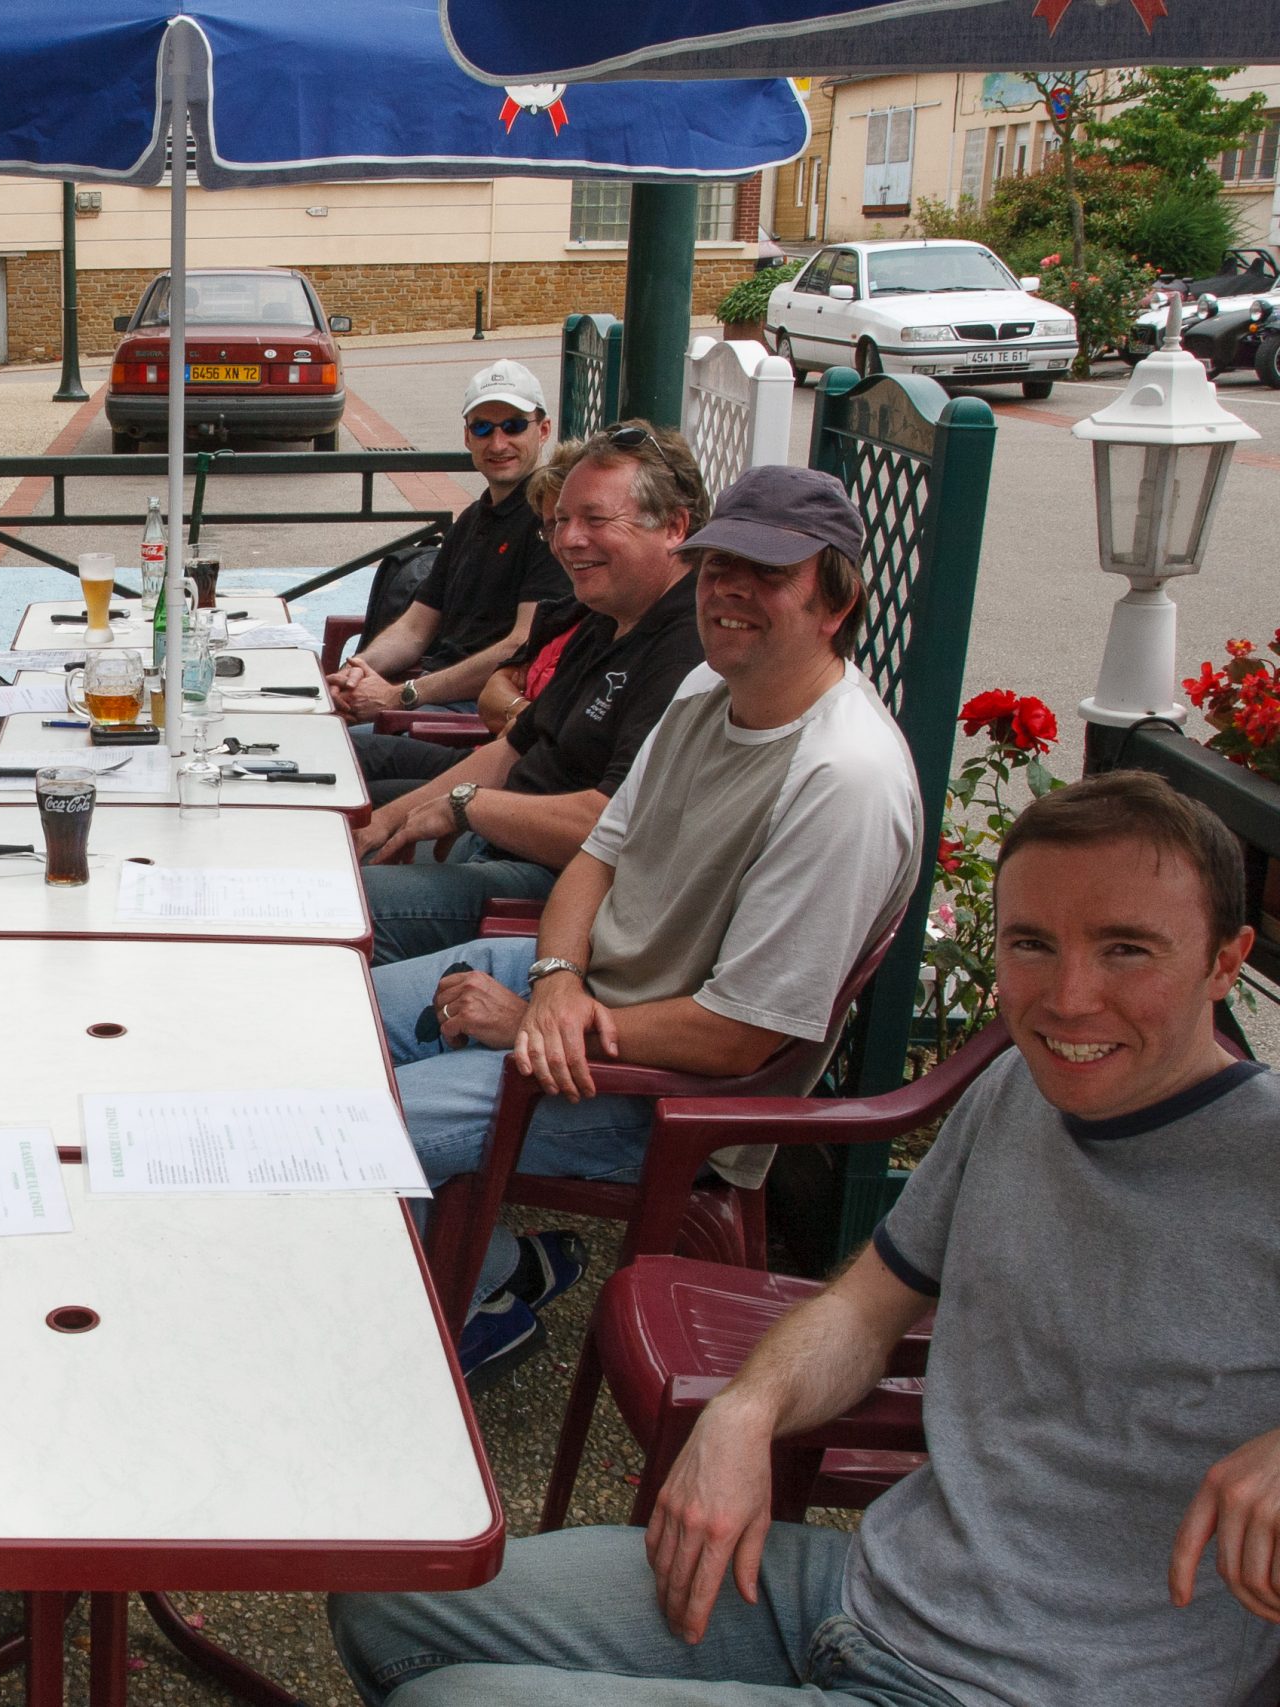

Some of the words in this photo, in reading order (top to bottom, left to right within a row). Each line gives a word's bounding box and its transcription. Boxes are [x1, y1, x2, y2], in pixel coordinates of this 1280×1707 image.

[972, 352, 994, 363] 4541
[998, 351, 1009, 362] TE
[1012, 351, 1023, 362] 61
[192, 366, 220, 380] 6456
[225, 366, 239, 379] XN
[244, 366, 258, 380] 72
[44, 794, 92, 813] Coca-Cola
